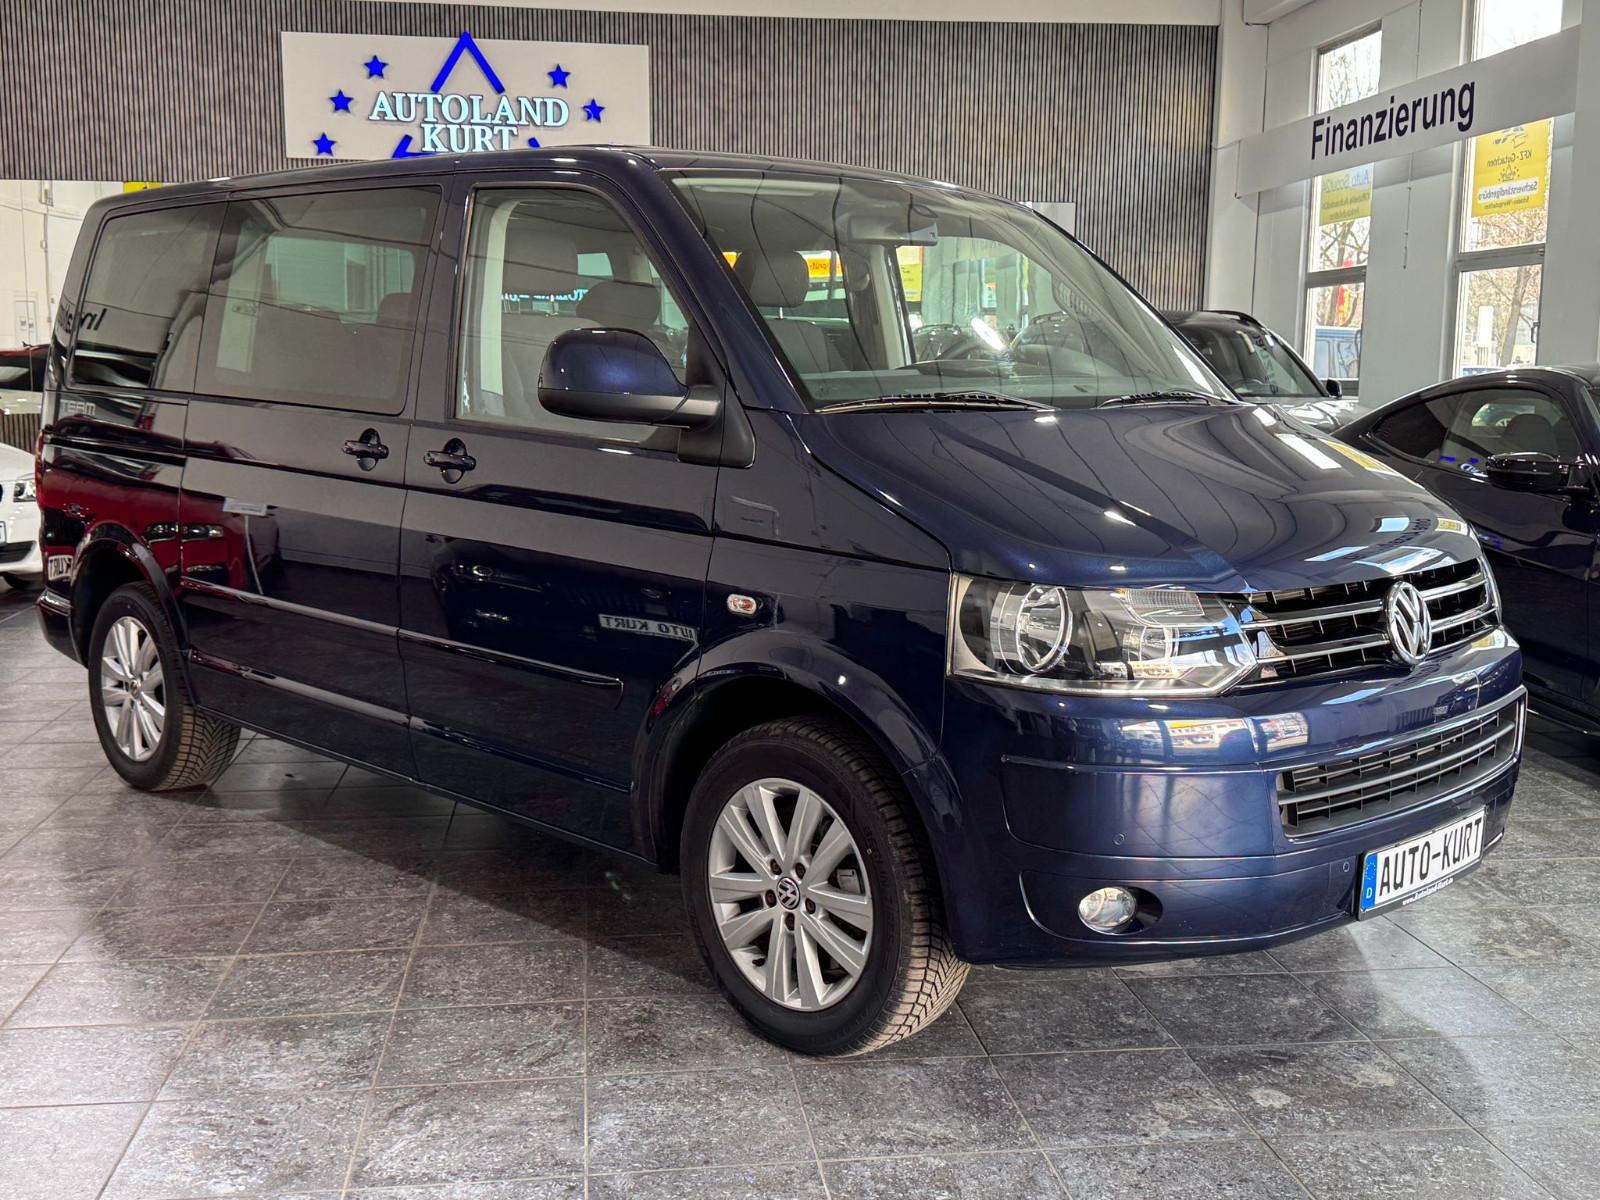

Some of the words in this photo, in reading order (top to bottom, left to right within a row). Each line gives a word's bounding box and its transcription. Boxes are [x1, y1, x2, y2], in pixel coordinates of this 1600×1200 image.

[368, 91, 570, 127] AUTOLAND
[1311, 81, 1475, 160] Finanzierung
[421, 123, 518, 153] KURT
[1379, 817, 1482, 897] AUTO-KURT
[1366, 888, 1373, 899] D
